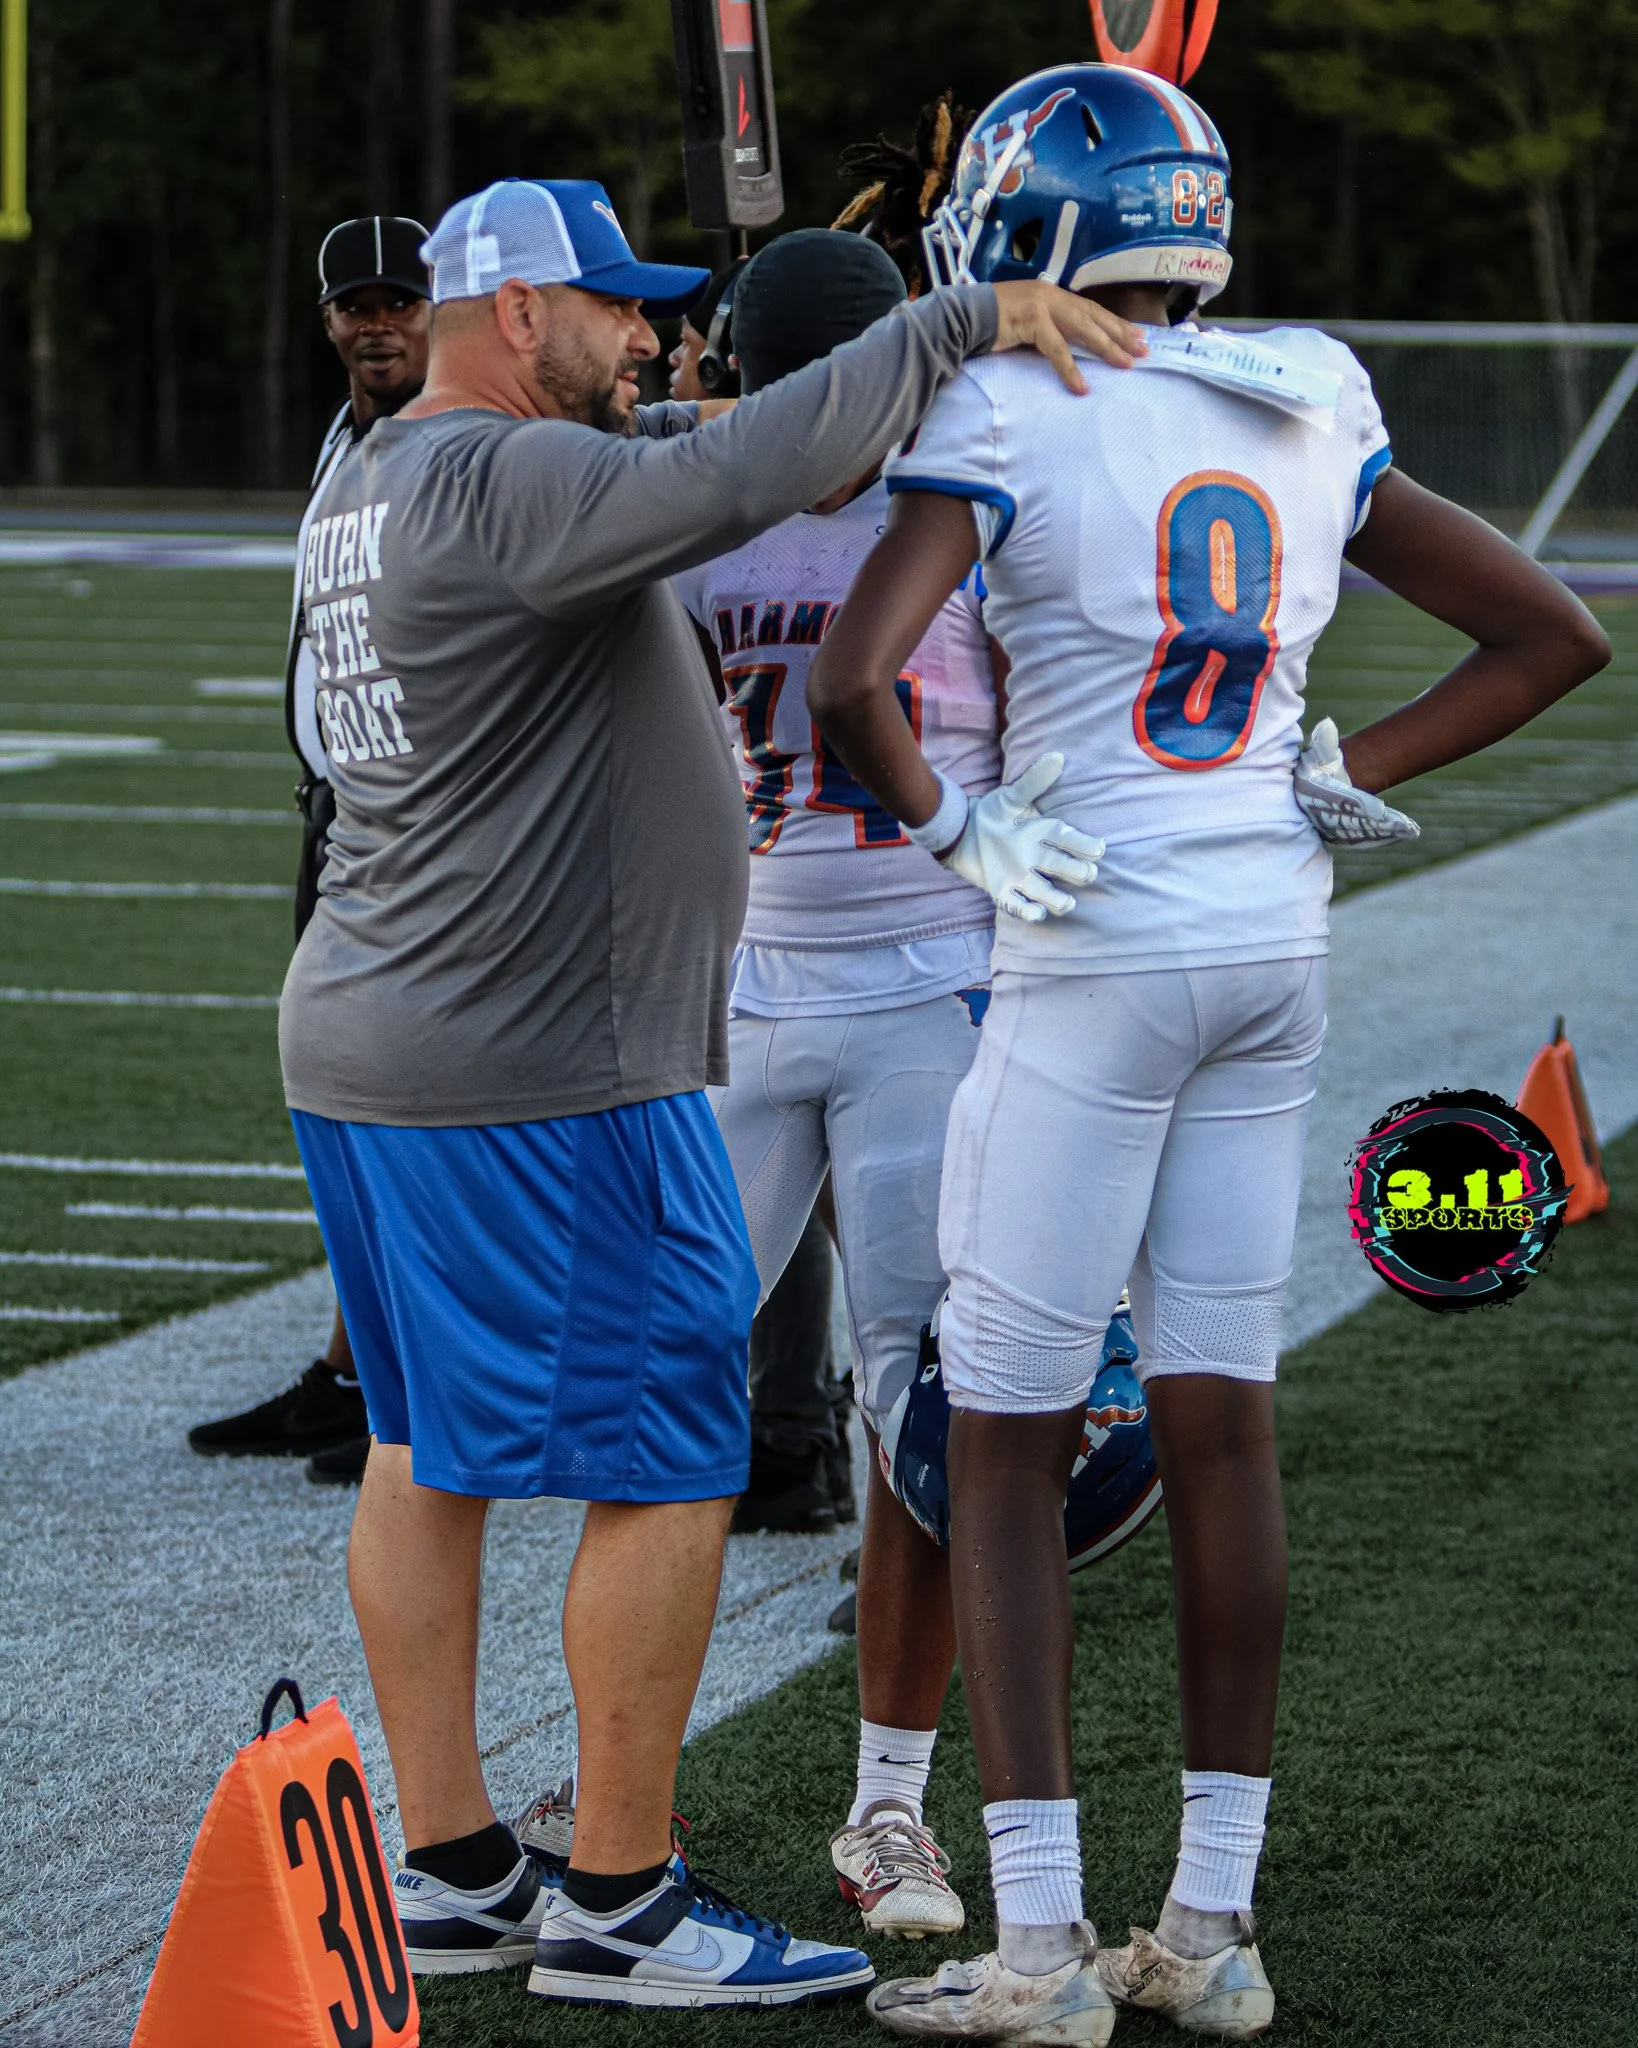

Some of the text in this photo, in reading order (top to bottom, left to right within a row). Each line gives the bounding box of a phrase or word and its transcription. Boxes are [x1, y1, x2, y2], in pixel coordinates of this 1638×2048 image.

[1172, 169, 1225, 227] 82
[304, 502, 389, 598] BURN
[311, 593, 381, 680] THE
[1132, 469, 1283, 771] 8
[279, 1758, 411, 2048] 30
[395, 1872, 425, 1891] NIKE
